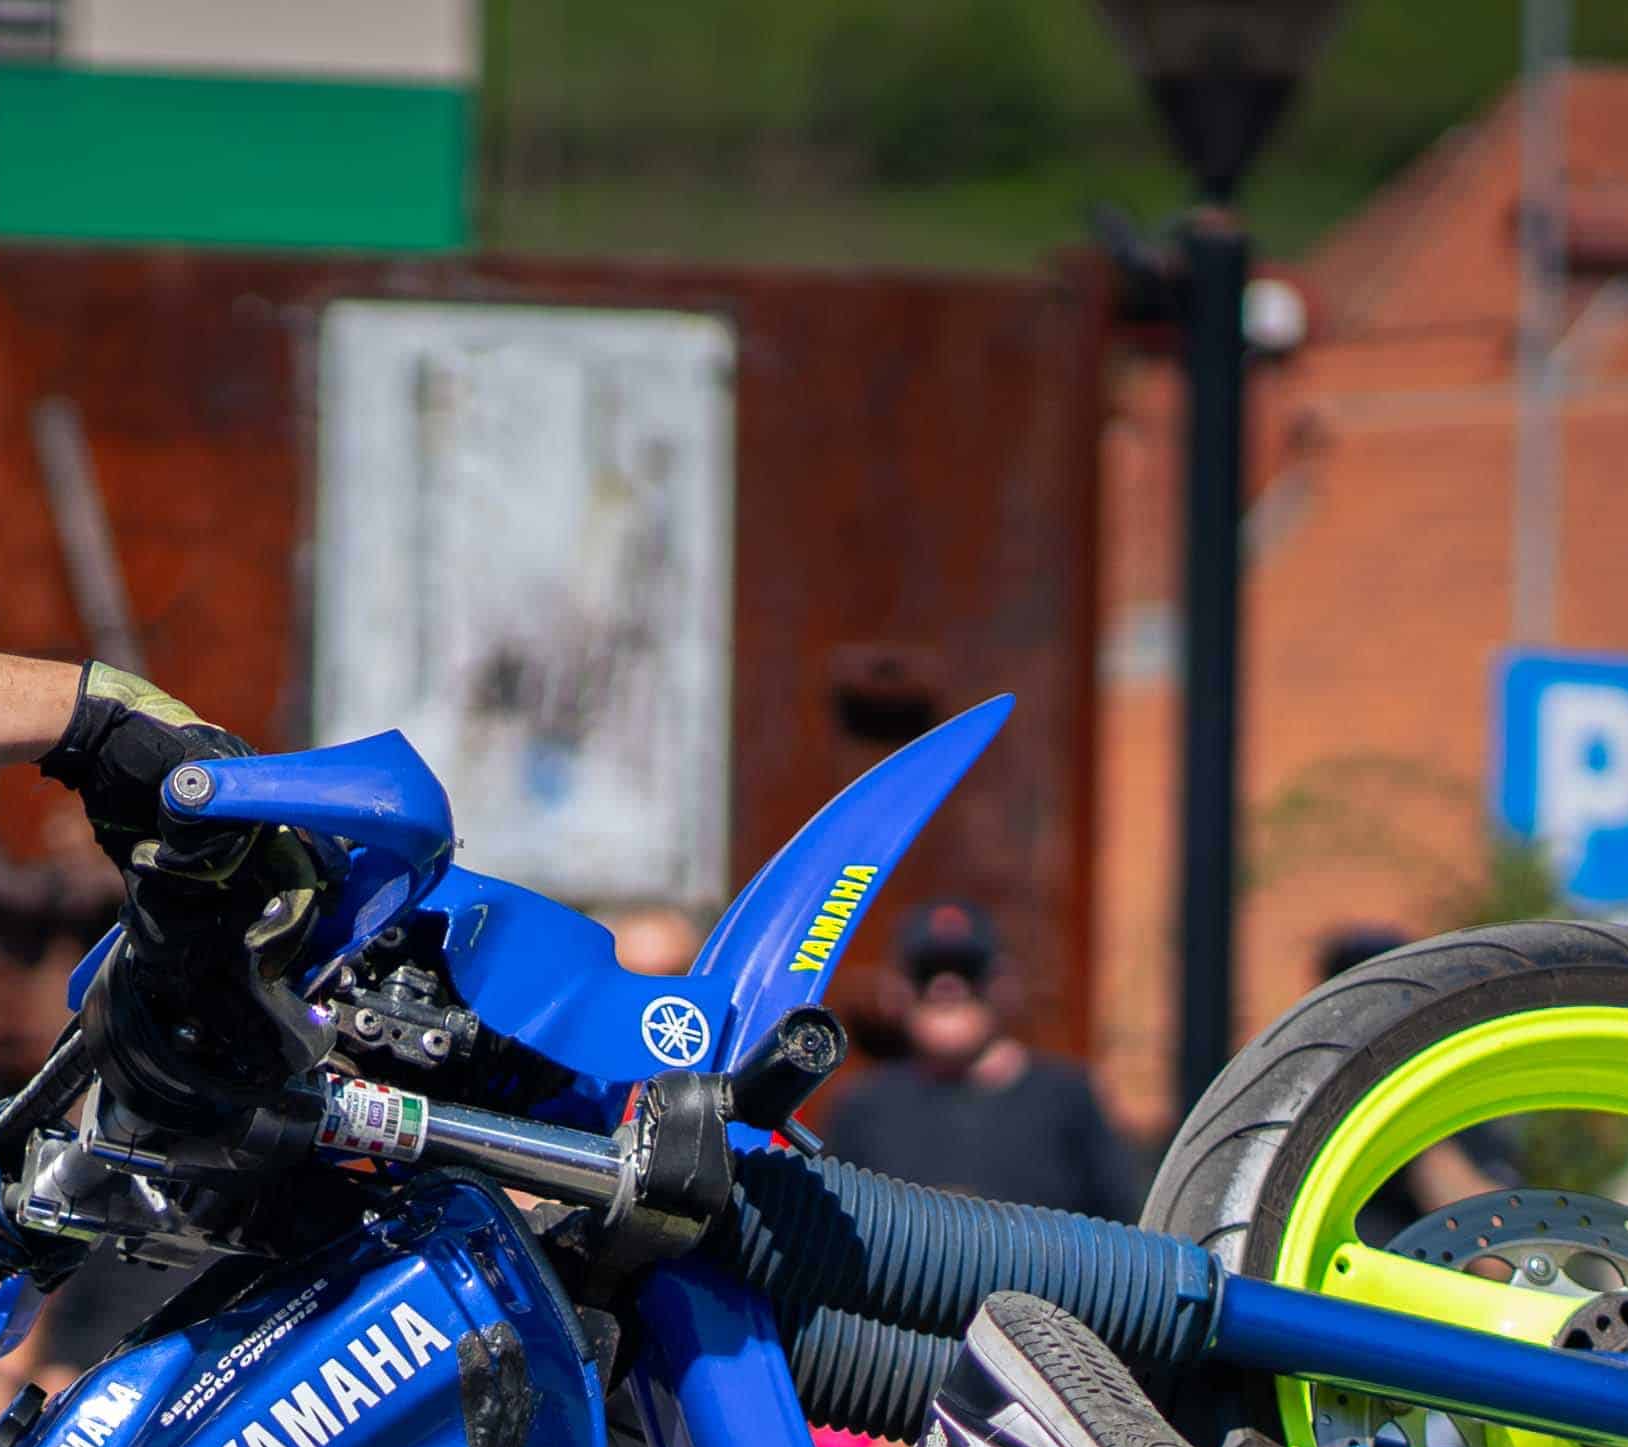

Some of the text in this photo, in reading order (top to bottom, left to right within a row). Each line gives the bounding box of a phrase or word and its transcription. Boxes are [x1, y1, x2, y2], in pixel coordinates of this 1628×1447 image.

[790, 864, 878, 973] YAMAHA
[186, 1300, 319, 1421] moto oprema
[217, 1277, 329, 1370] COMMERCE
